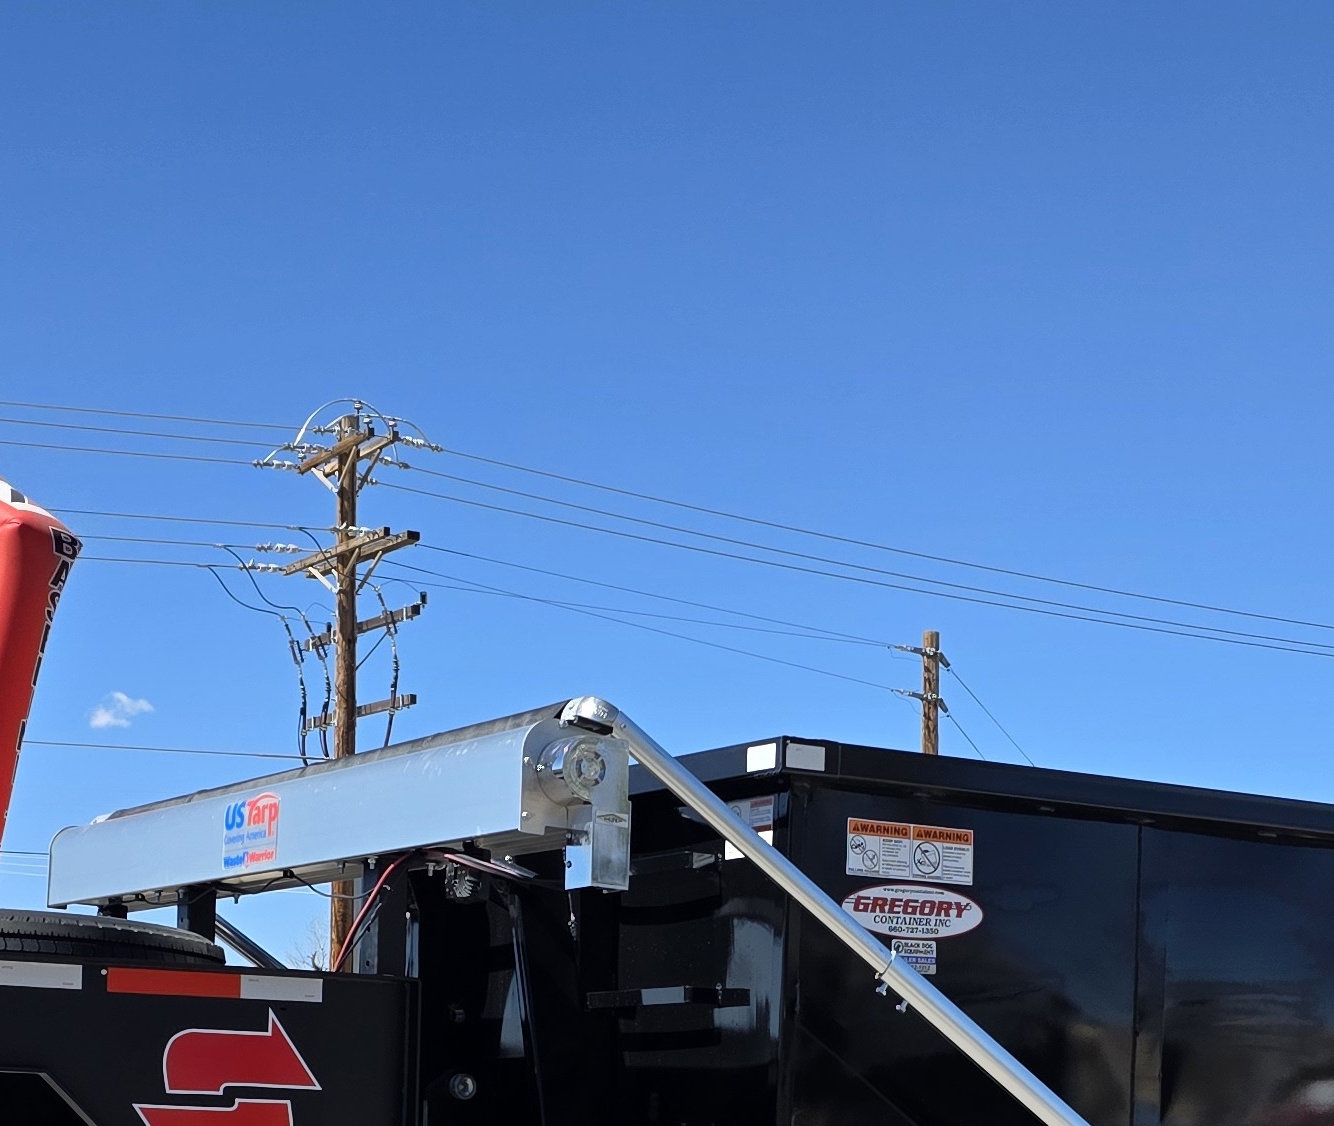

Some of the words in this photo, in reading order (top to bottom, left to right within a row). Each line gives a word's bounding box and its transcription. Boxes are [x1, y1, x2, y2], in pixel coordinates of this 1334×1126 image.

[860, 823, 908, 836] WARNING
[922, 830, 969, 842] WARNING
[853, 896, 967, 918] GREGORY
[874, 915, 931, 927] CONTAINER
[934, 919, 951, 928] INC
